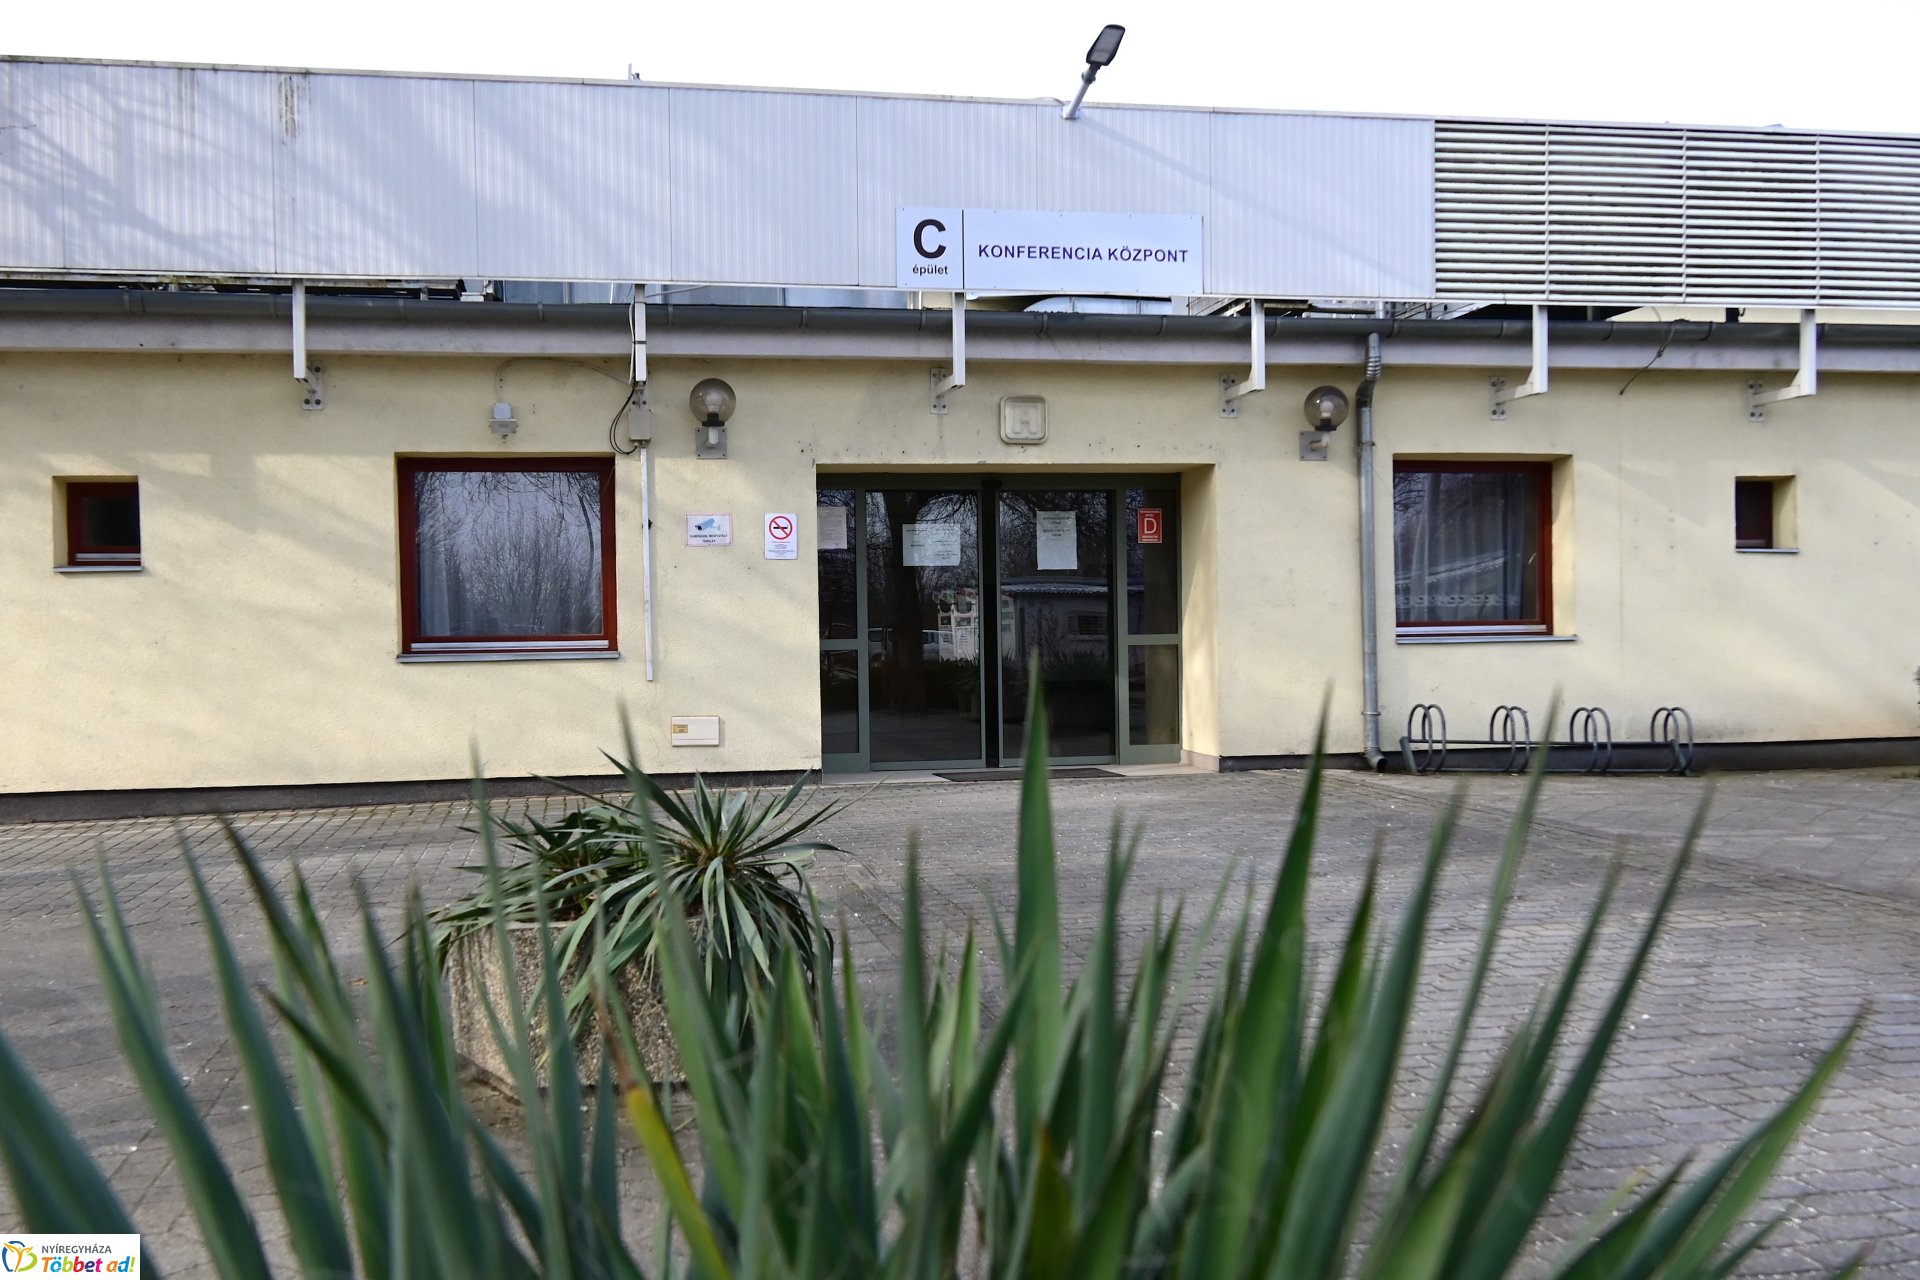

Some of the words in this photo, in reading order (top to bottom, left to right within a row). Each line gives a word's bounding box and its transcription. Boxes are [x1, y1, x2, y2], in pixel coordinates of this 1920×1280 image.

[913, 218, 947, 259] C
[978, 243, 1103, 261] KONFERENCIA
[1108, 245, 1189, 263] KÖZPONT
[912, 263, 949, 277] épület
[1144, 517, 1157, 534] D
